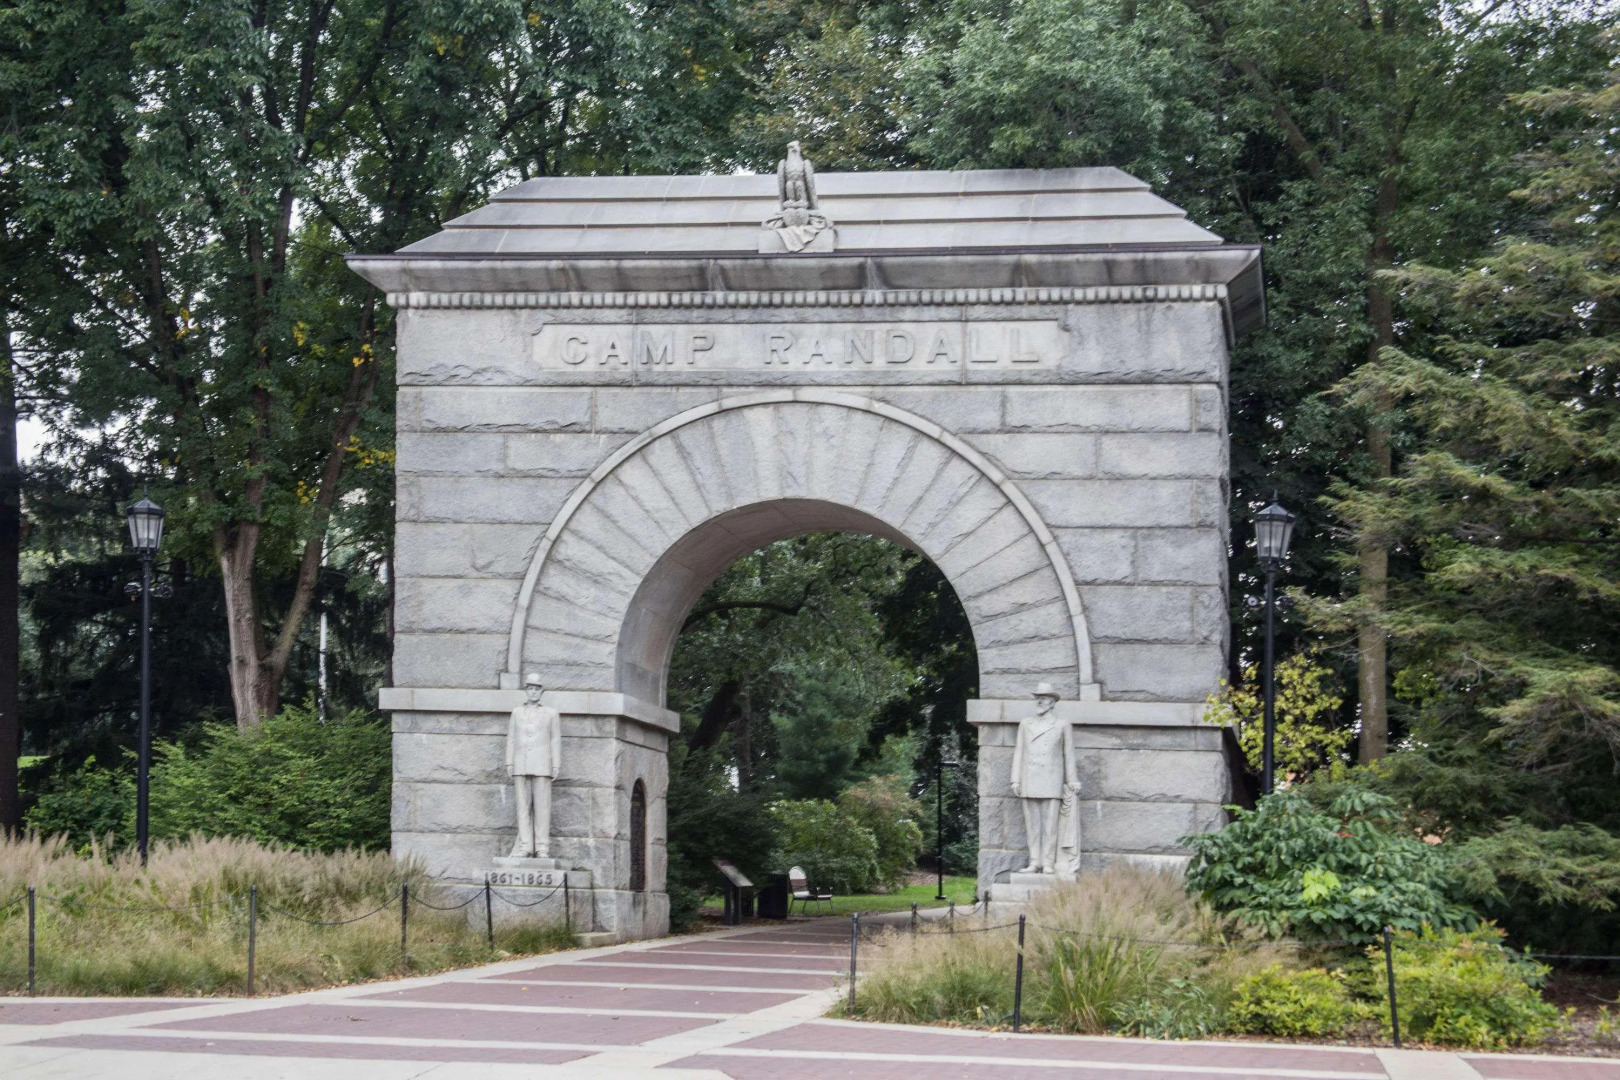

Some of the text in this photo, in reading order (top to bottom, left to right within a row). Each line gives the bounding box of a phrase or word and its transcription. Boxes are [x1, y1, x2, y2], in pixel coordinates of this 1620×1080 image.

[560, 328, 1040, 366] CAMP RANDALL
[484, 871, 553, 886] 1861-1865
